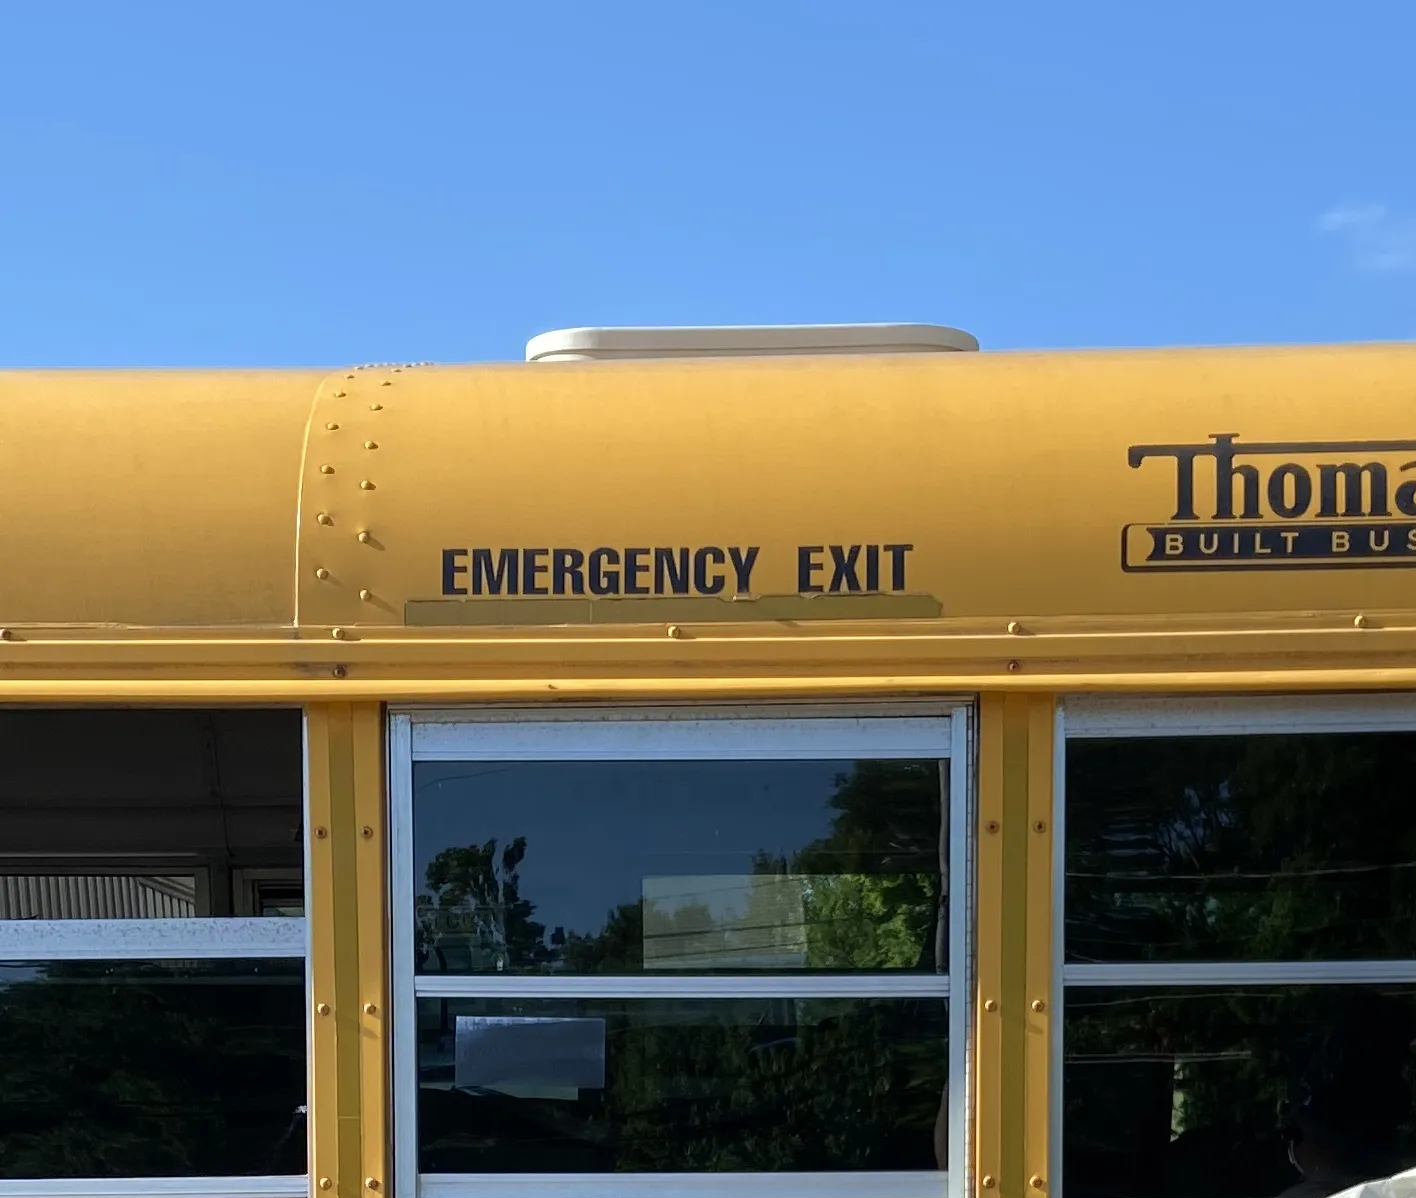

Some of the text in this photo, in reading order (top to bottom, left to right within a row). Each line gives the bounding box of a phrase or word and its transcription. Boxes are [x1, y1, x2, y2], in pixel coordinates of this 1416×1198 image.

[1164, 531, 1298, 556] BUILT
[442, 544, 914, 596] EMERGENCY EXIT
